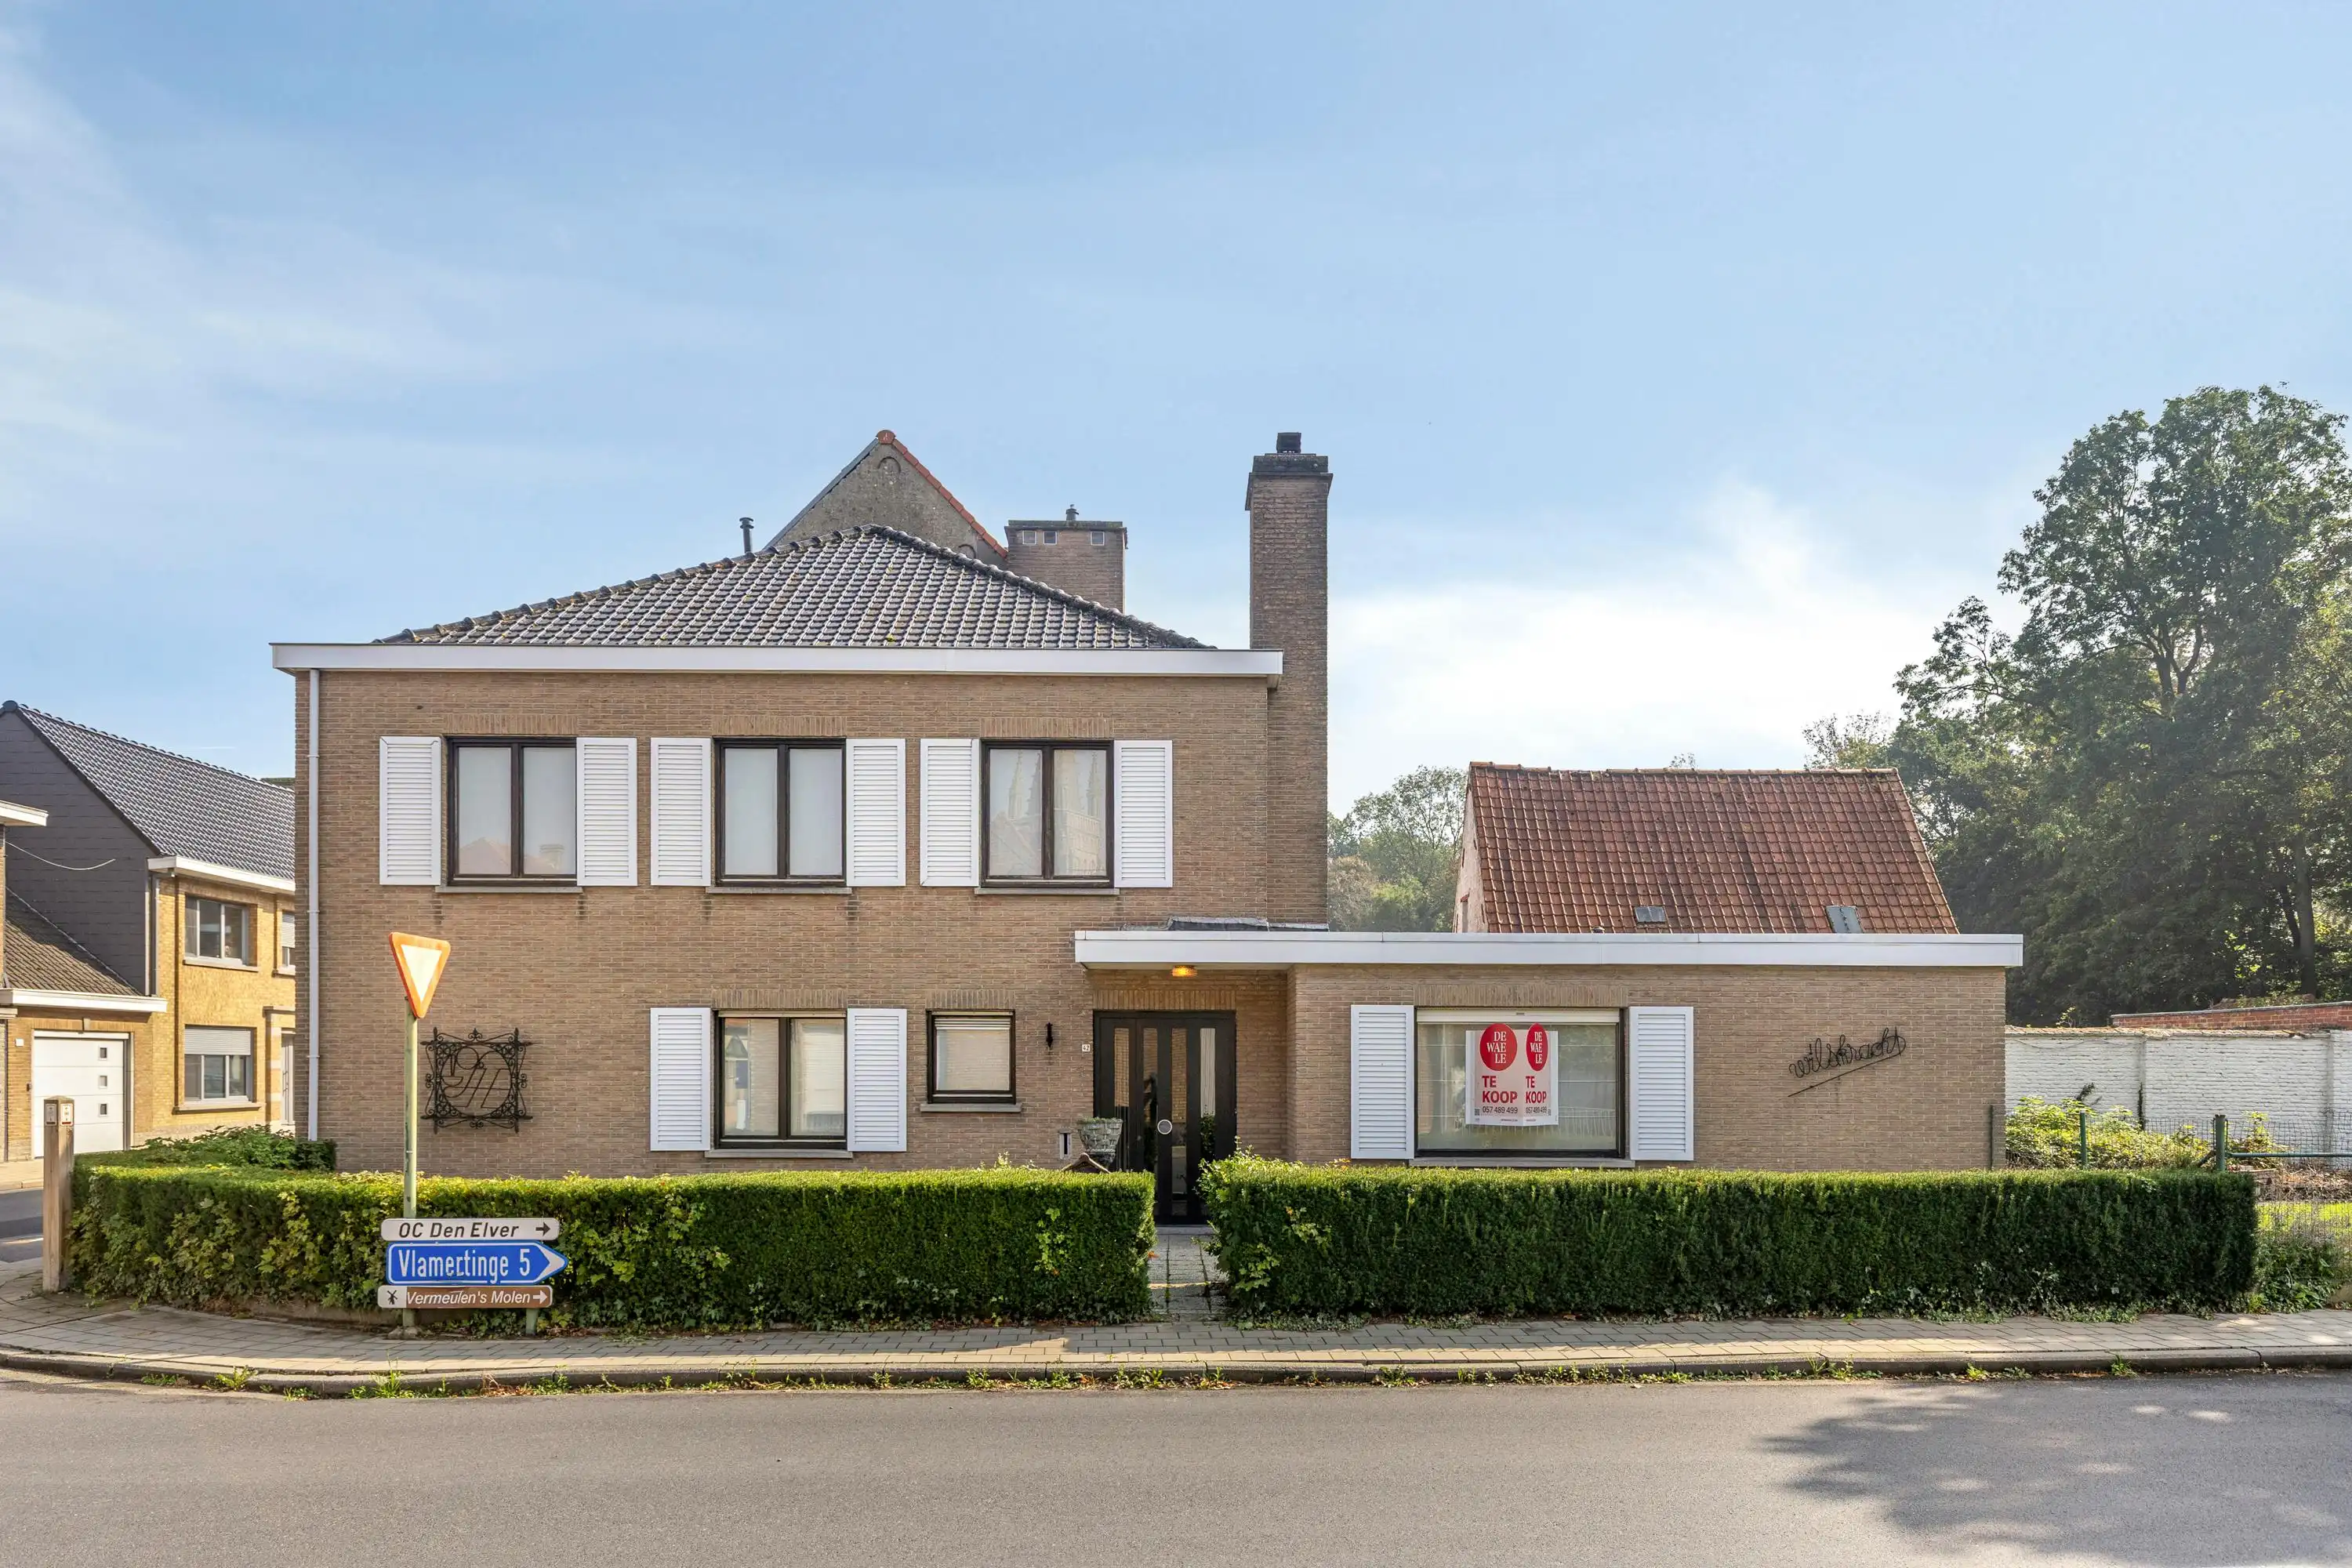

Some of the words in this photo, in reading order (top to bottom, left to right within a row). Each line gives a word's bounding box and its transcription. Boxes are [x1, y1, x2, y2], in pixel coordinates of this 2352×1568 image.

[1494, 1031, 1506, 1041] DE
[1534, 1032, 1542, 1041] DE
[1486, 1043, 1506, 1053] WAE
[1530, 1043, 1542, 1053] WAE
[1495, 1054, 1506, 1064] LE
[1536, 1054, 1542, 1064] LE
[1482, 1076, 1497, 1087] TE
[1526, 1076, 1535, 1088] TE
[1483, 1091, 1518, 1103] KOOP
[1526, 1091, 1547, 1103] KOOP
[399, 1222, 423, 1238] OC
[430, 1222, 465, 1238] Den
[470, 1222, 519, 1237] Elver
[398, 1250, 509, 1284] Vlamertinge
[519, 1248, 531, 1277] 5
[407, 1290, 487, 1305] Vermeulen's
[491, 1290, 530, 1304] Molen
